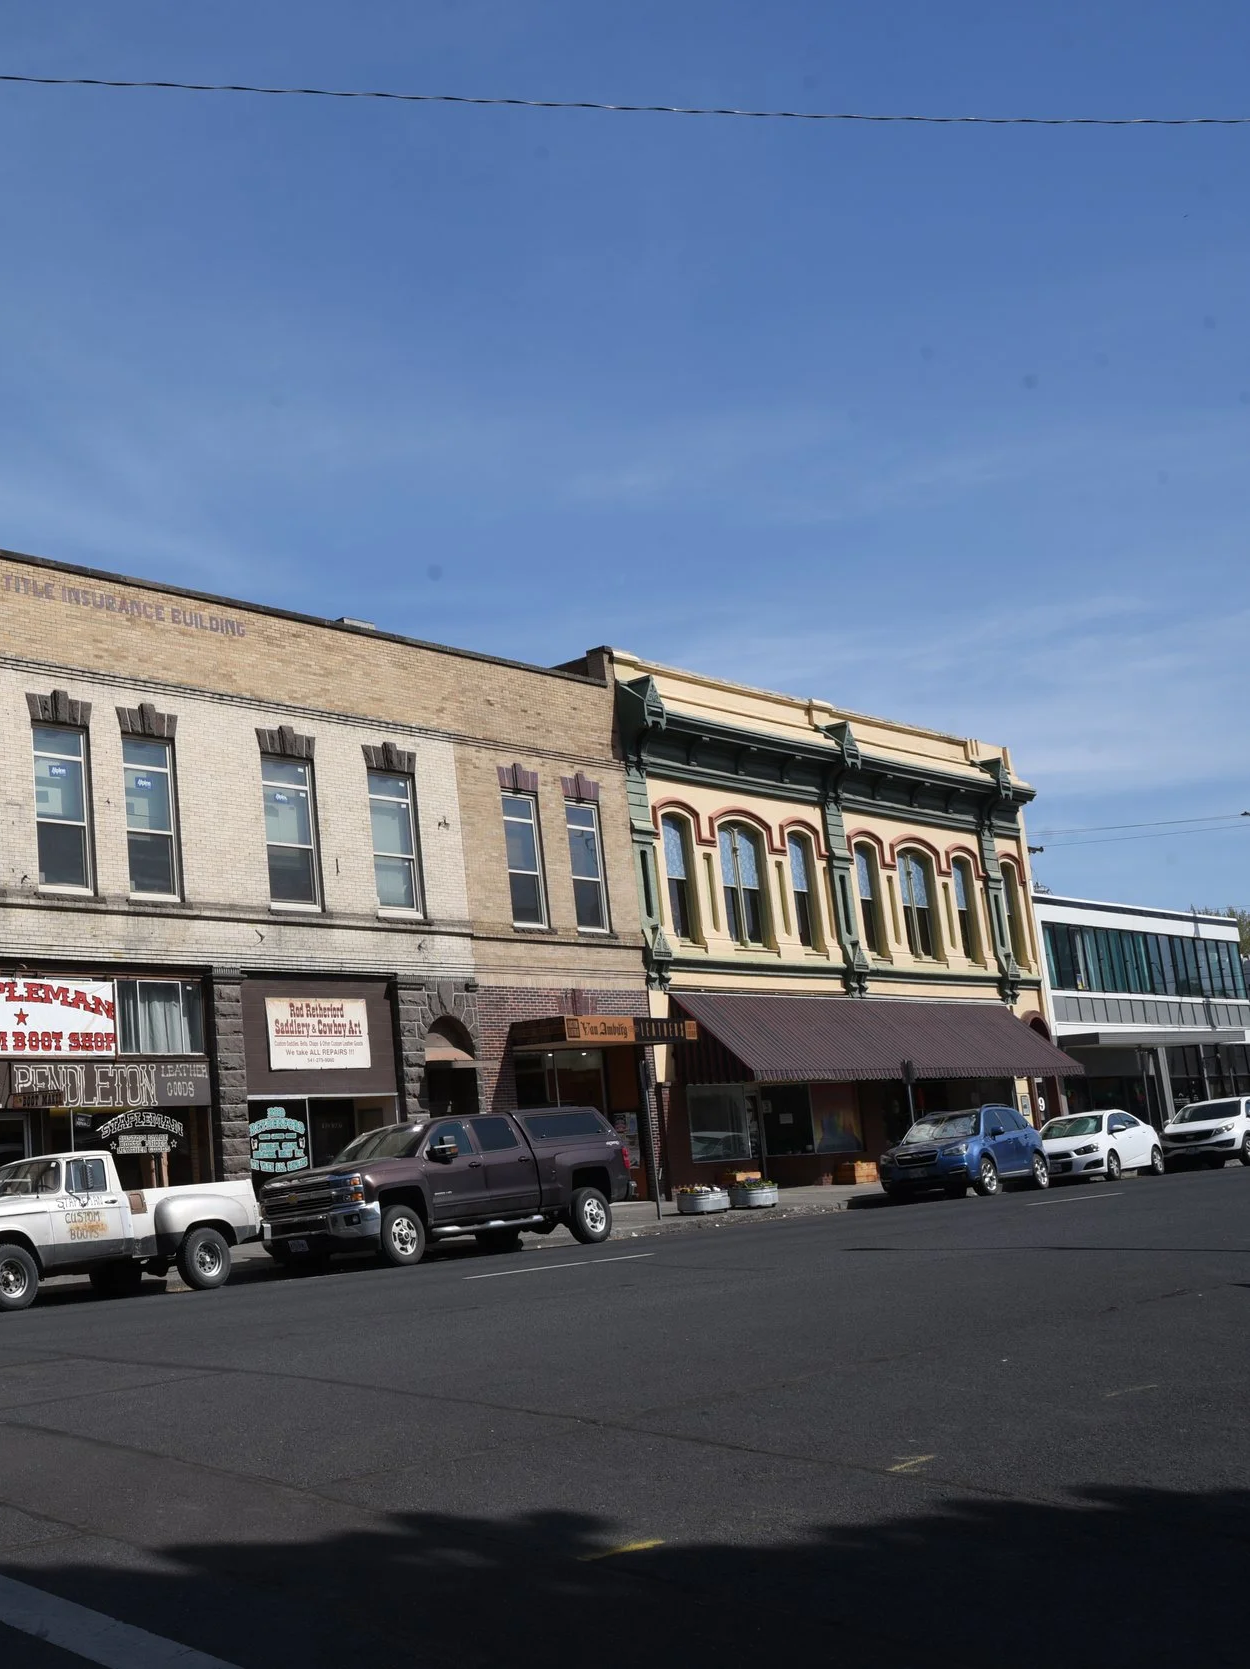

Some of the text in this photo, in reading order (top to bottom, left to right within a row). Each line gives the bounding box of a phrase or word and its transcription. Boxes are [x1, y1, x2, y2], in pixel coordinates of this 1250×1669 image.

[3, 575, 246, 637] TITLE INSURANCE BUILDING
[289, 1003, 344, 1018] Rod Retherford
[274, 1019, 362, 1038] Saddlery & Cowboy Art
[581, 1022, 598, 1036] Van
[12, 1031, 63, 1051] BOOT
[68, 1032, 116, 1051] SHOP
[160, 1064, 208, 1079] LEATHER
[14, 1064, 158, 1108] PENDLETON
[167, 1081, 195, 1097] GOODS
[23, 1095, 39, 1107] BOOT
[1038, 1096, 1045, 1111] 9
[101, 1112, 184, 1139] STAPLEMAN
[116, 1146, 147, 1154] LEATHER
[65, 1211, 100, 1224] CUSTOM
[70, 1228, 99, 1240] BOOTS
